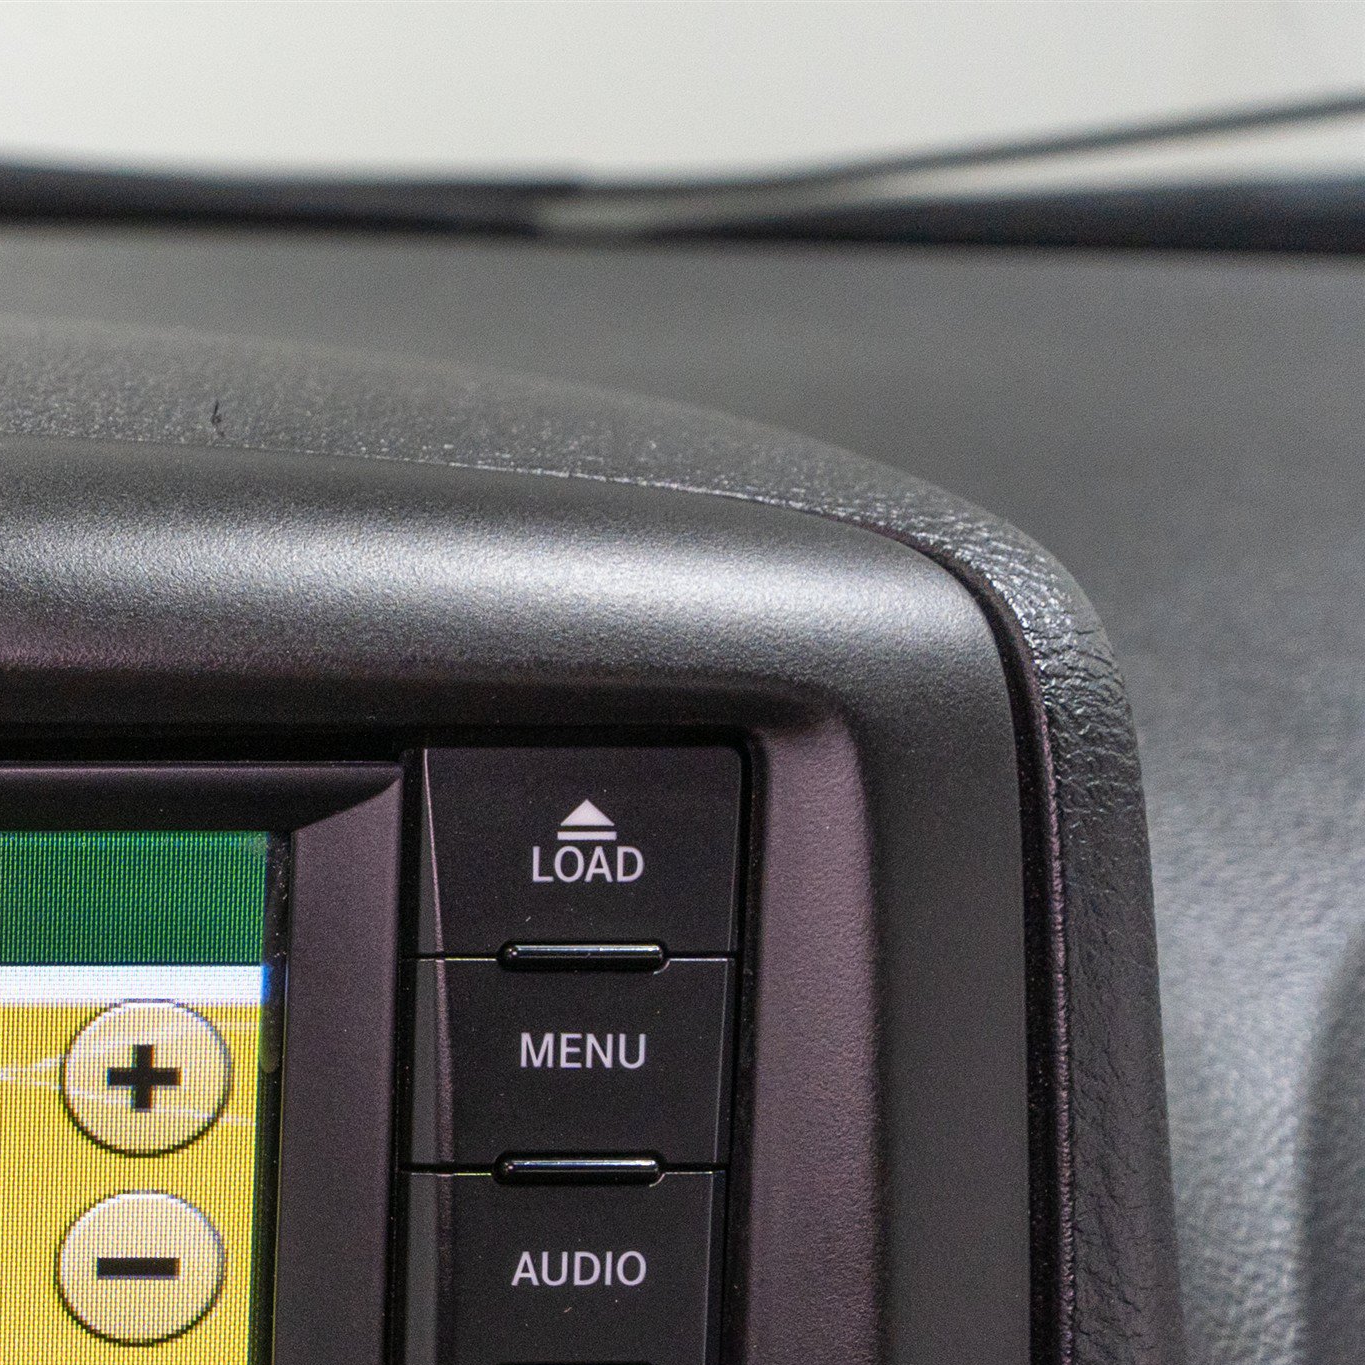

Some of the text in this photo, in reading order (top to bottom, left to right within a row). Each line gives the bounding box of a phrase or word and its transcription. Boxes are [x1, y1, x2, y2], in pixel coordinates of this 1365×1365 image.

[531, 846, 644, 883] LOAD
[519, 1033, 646, 1068] MENU
[511, 1250, 646, 1286] AUDIO
